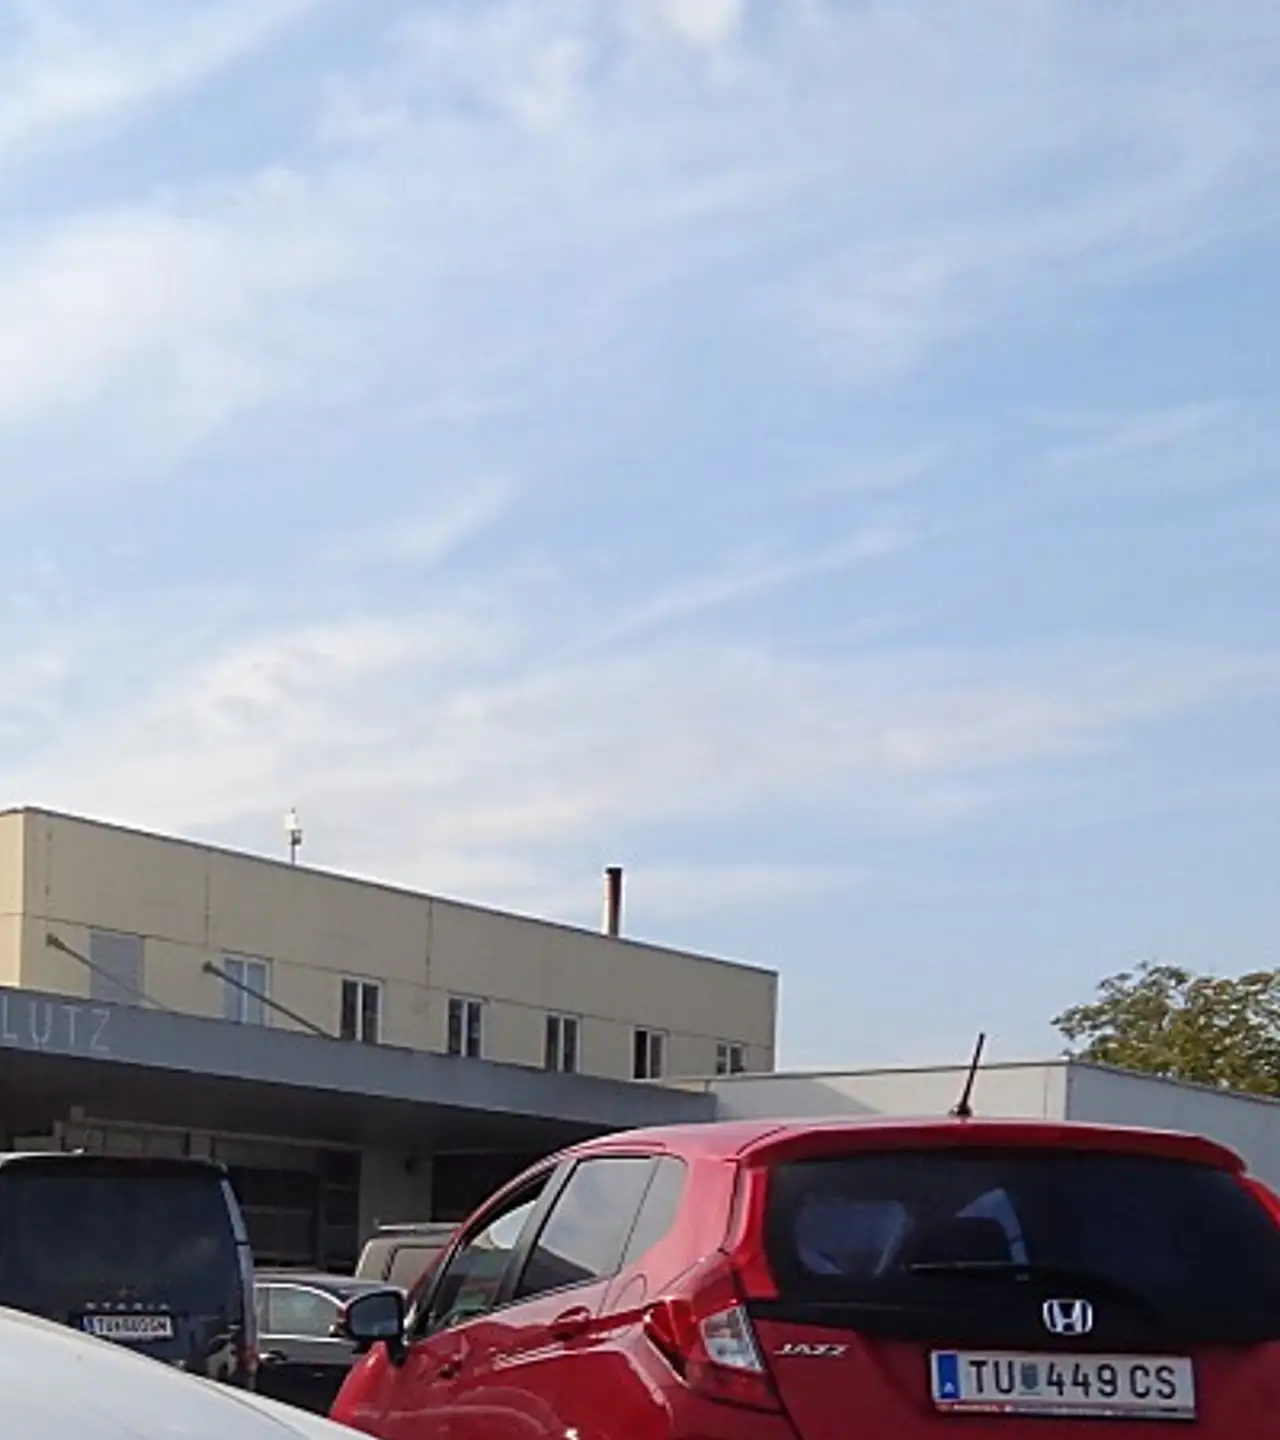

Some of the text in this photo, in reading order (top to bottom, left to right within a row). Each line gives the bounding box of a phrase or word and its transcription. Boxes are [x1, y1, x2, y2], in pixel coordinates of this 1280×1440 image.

[1, 996, 112, 1051] LUTZ
[773, 1343, 852, 1357] JAZZ
[969, 1360, 1016, 1395] TU
